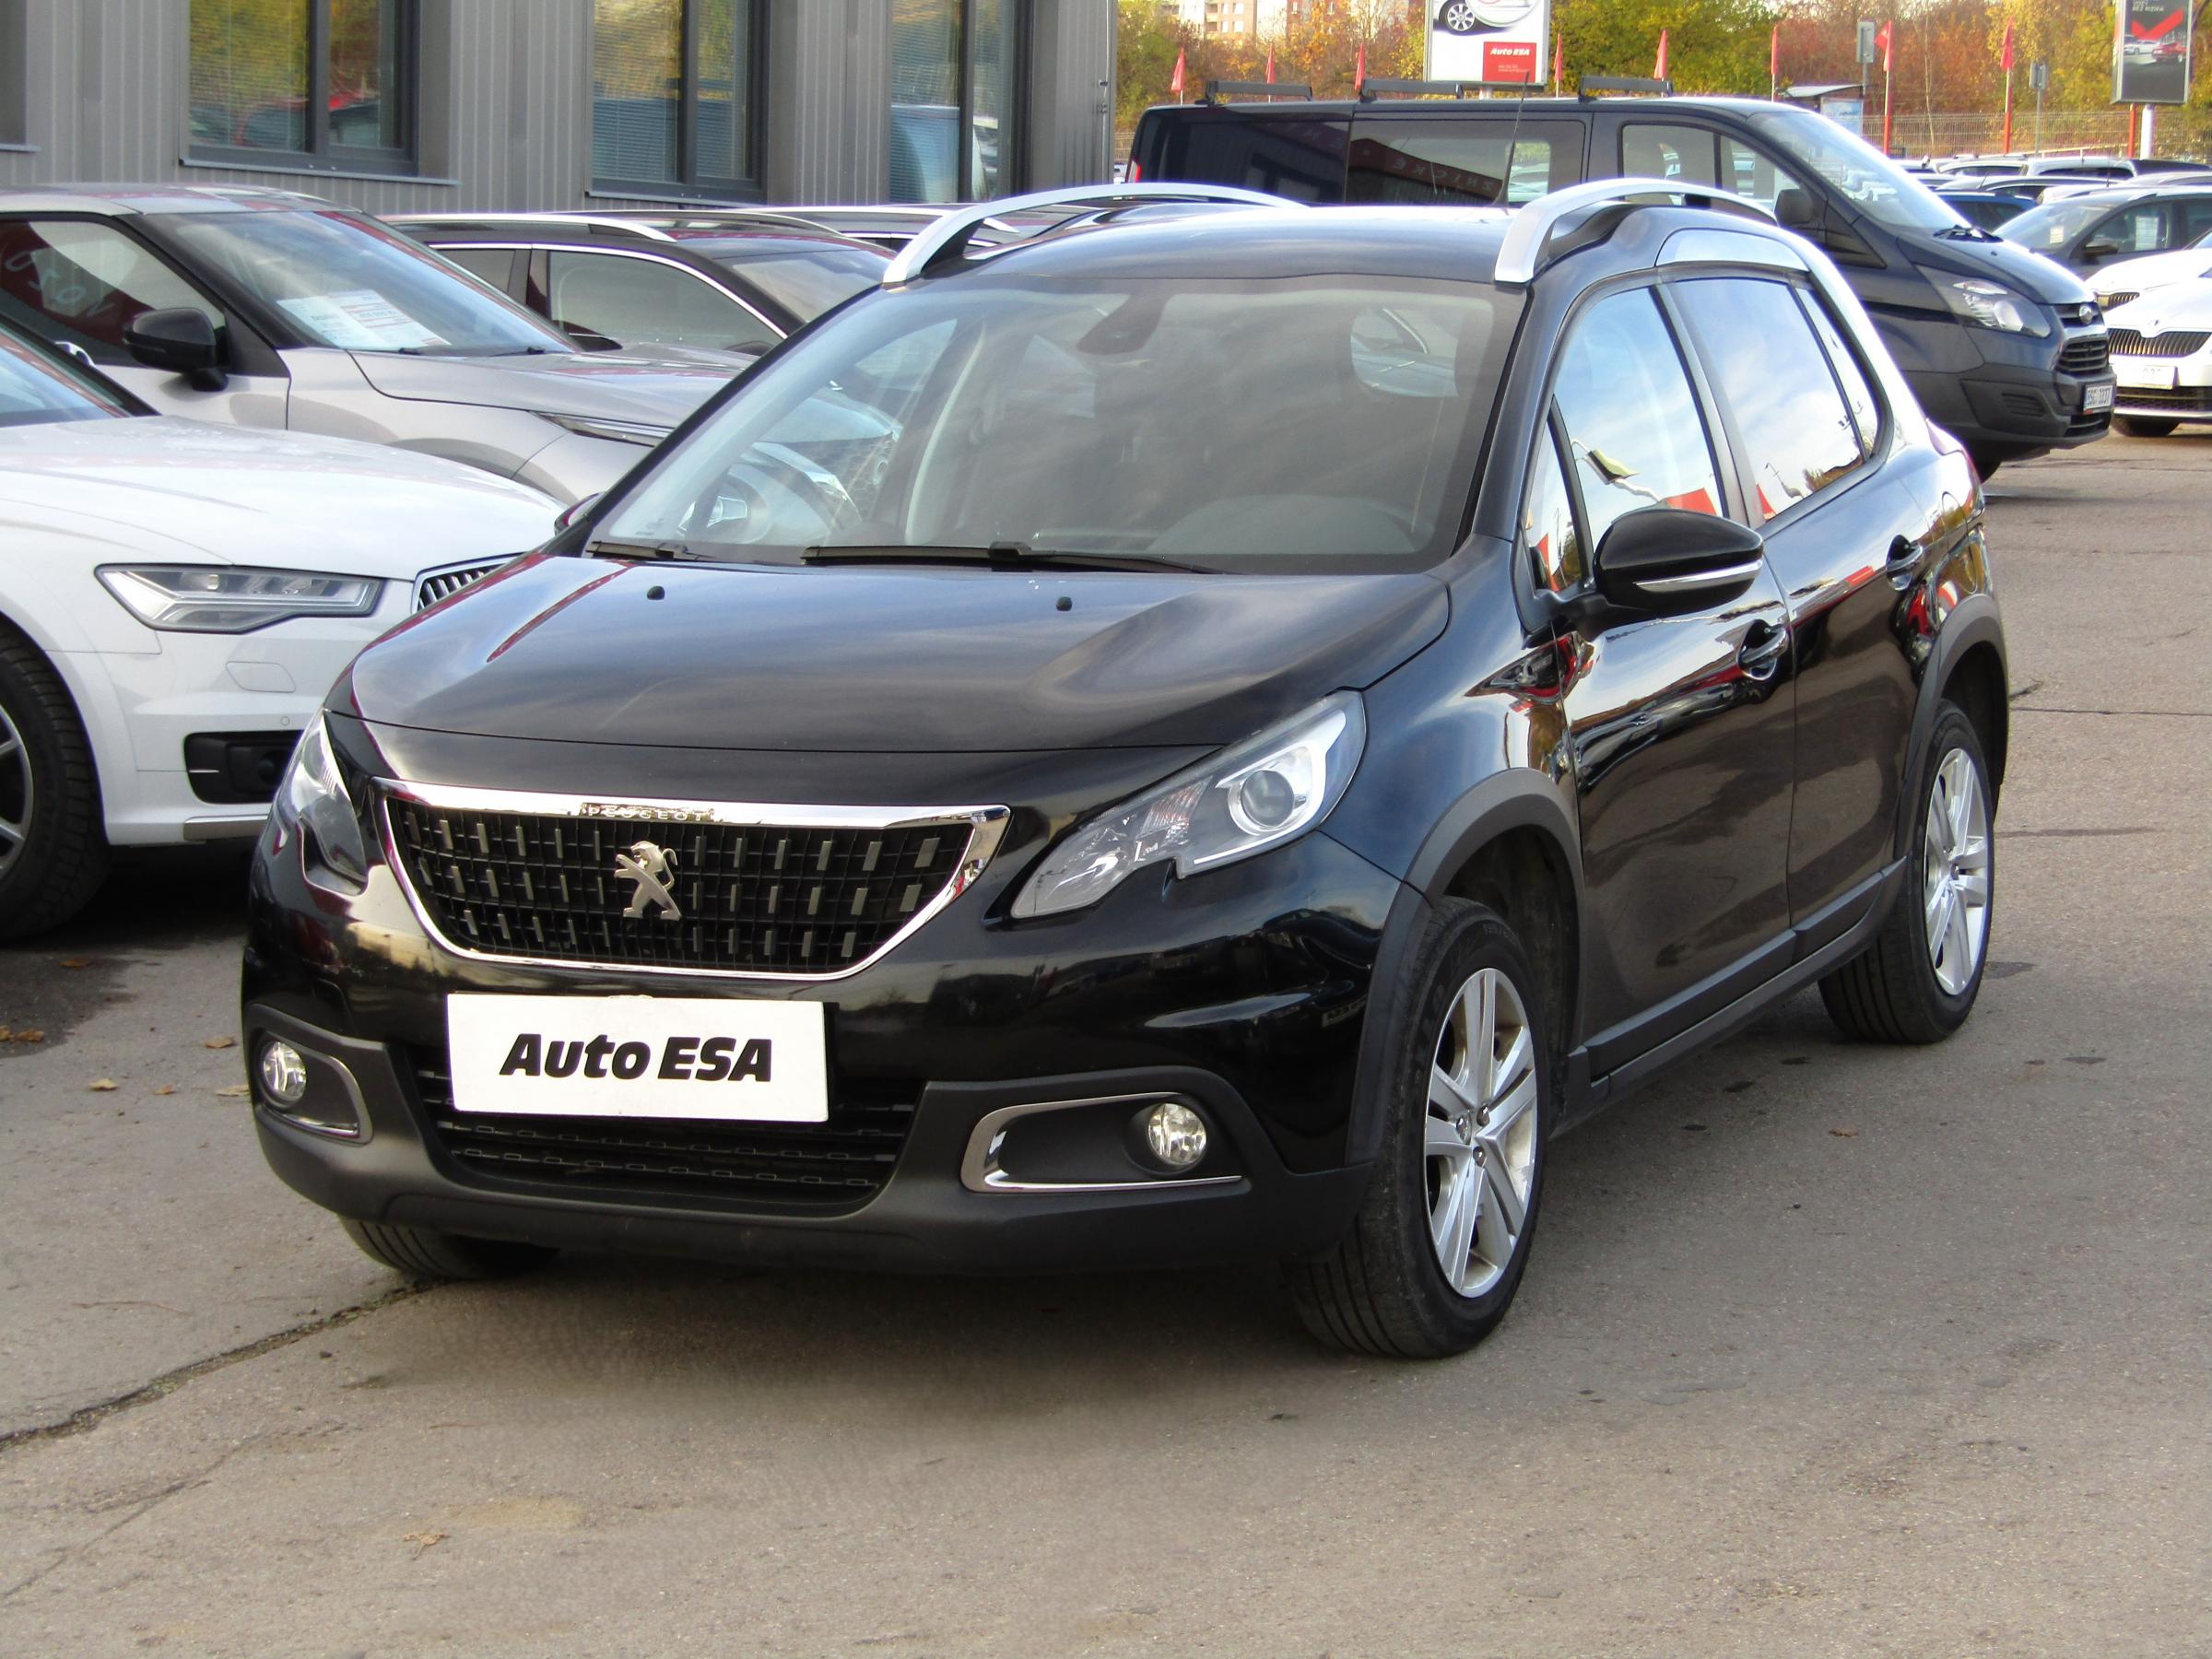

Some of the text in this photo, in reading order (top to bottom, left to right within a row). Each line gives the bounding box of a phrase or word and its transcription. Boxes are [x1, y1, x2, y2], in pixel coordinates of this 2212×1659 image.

[587, 804, 703, 821] PEUGEOT
[499, 1033, 772, 1083] Auto ESA
